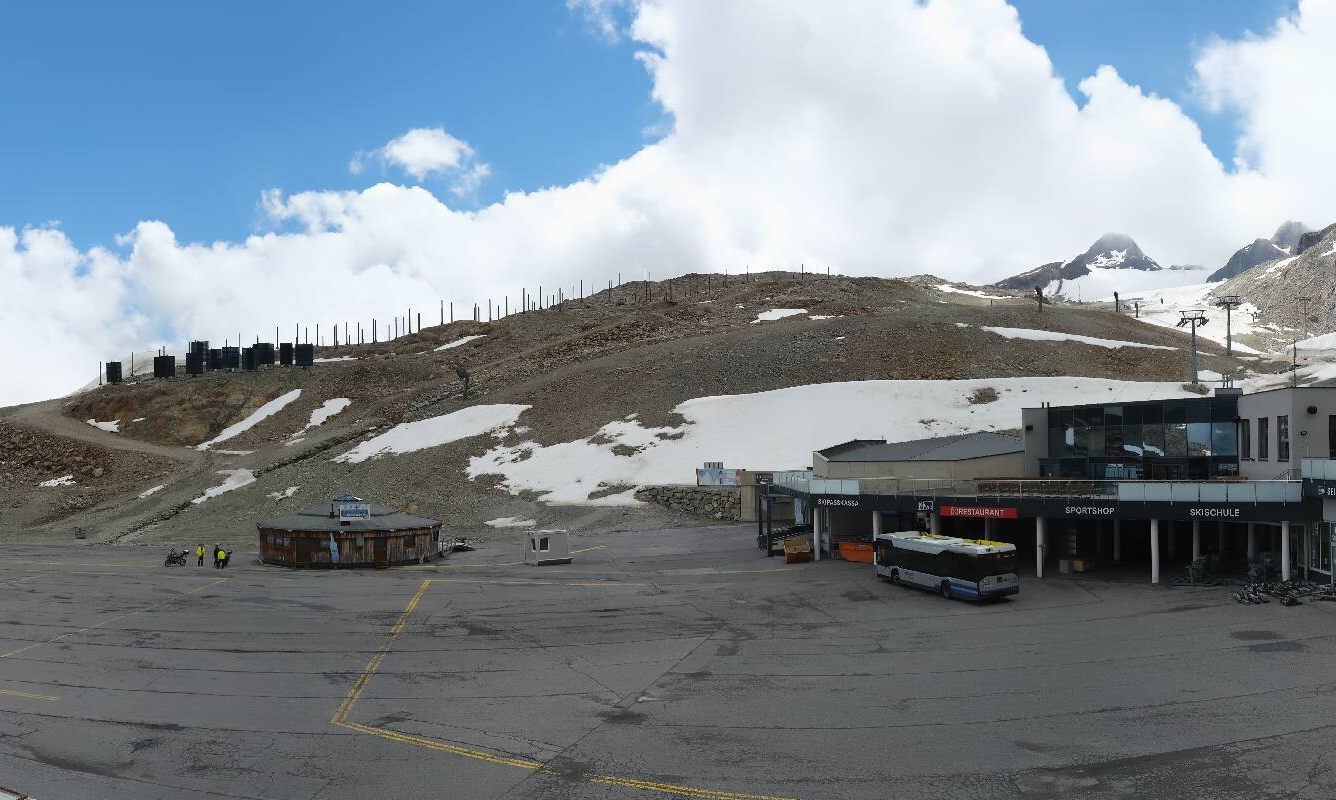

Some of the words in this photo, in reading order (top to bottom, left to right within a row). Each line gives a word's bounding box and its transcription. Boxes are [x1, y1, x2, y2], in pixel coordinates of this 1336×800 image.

[958, 508, 1005, 517] RESTAURANT
[1065, 506, 1115, 516] SPORTSHOP
[1189, 508, 1240, 517] SKISCHULE
